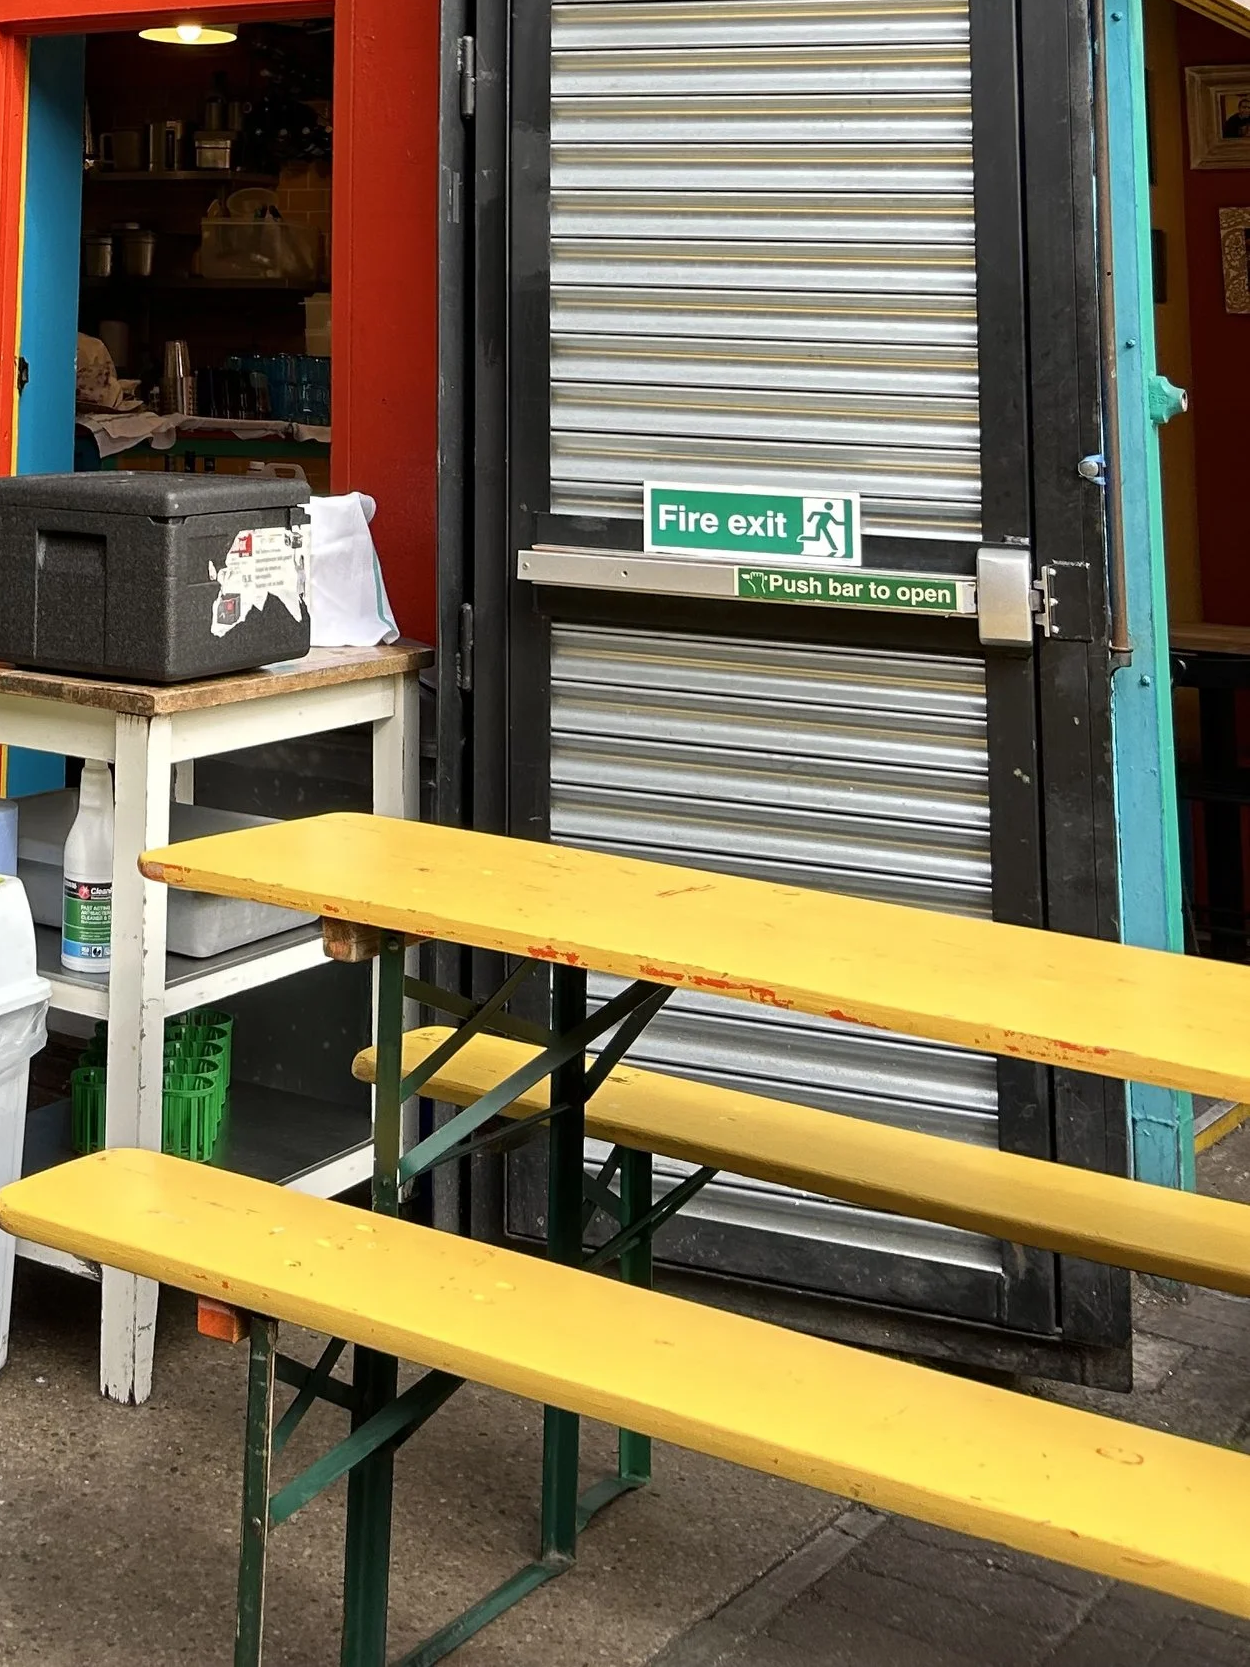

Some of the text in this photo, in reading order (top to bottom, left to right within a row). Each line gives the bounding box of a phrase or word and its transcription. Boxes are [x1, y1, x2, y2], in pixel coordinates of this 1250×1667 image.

[658, 503, 787, 538] Fire exit
[769, 574, 951, 605] Push bar to open
